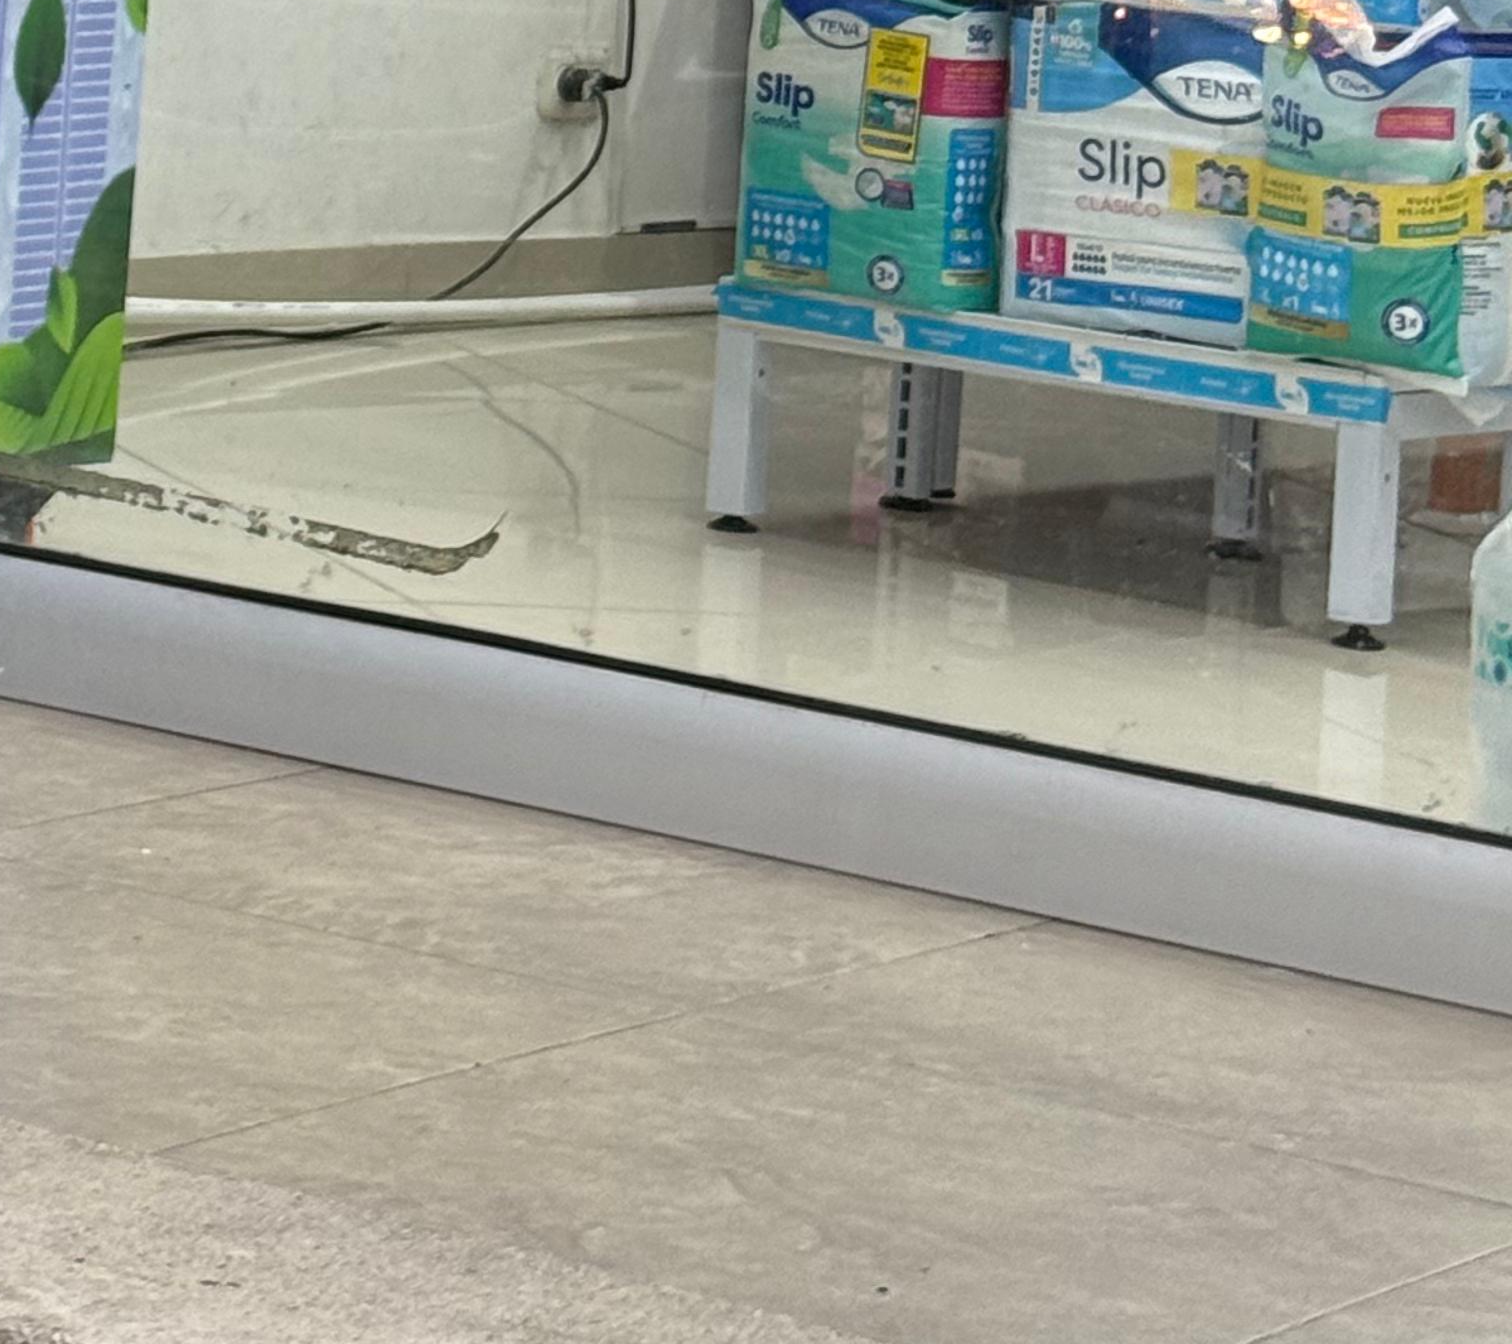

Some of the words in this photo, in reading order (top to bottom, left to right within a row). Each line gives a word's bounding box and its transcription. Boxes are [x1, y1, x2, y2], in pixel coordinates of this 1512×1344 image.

[817, 17, 860, 38] TENA
[966, 23, 995, 44] Slip
[755, 71, 815, 116] Slip
[1177, 75, 1254, 103] TENA
[751, 110, 802, 131] Comfort
[1271, 94, 1324, 144] Slip
[1077, 138, 1166, 199] Slip
[1028, 278, 1053, 300] 21
[1392, 313, 1419, 332] 3x
